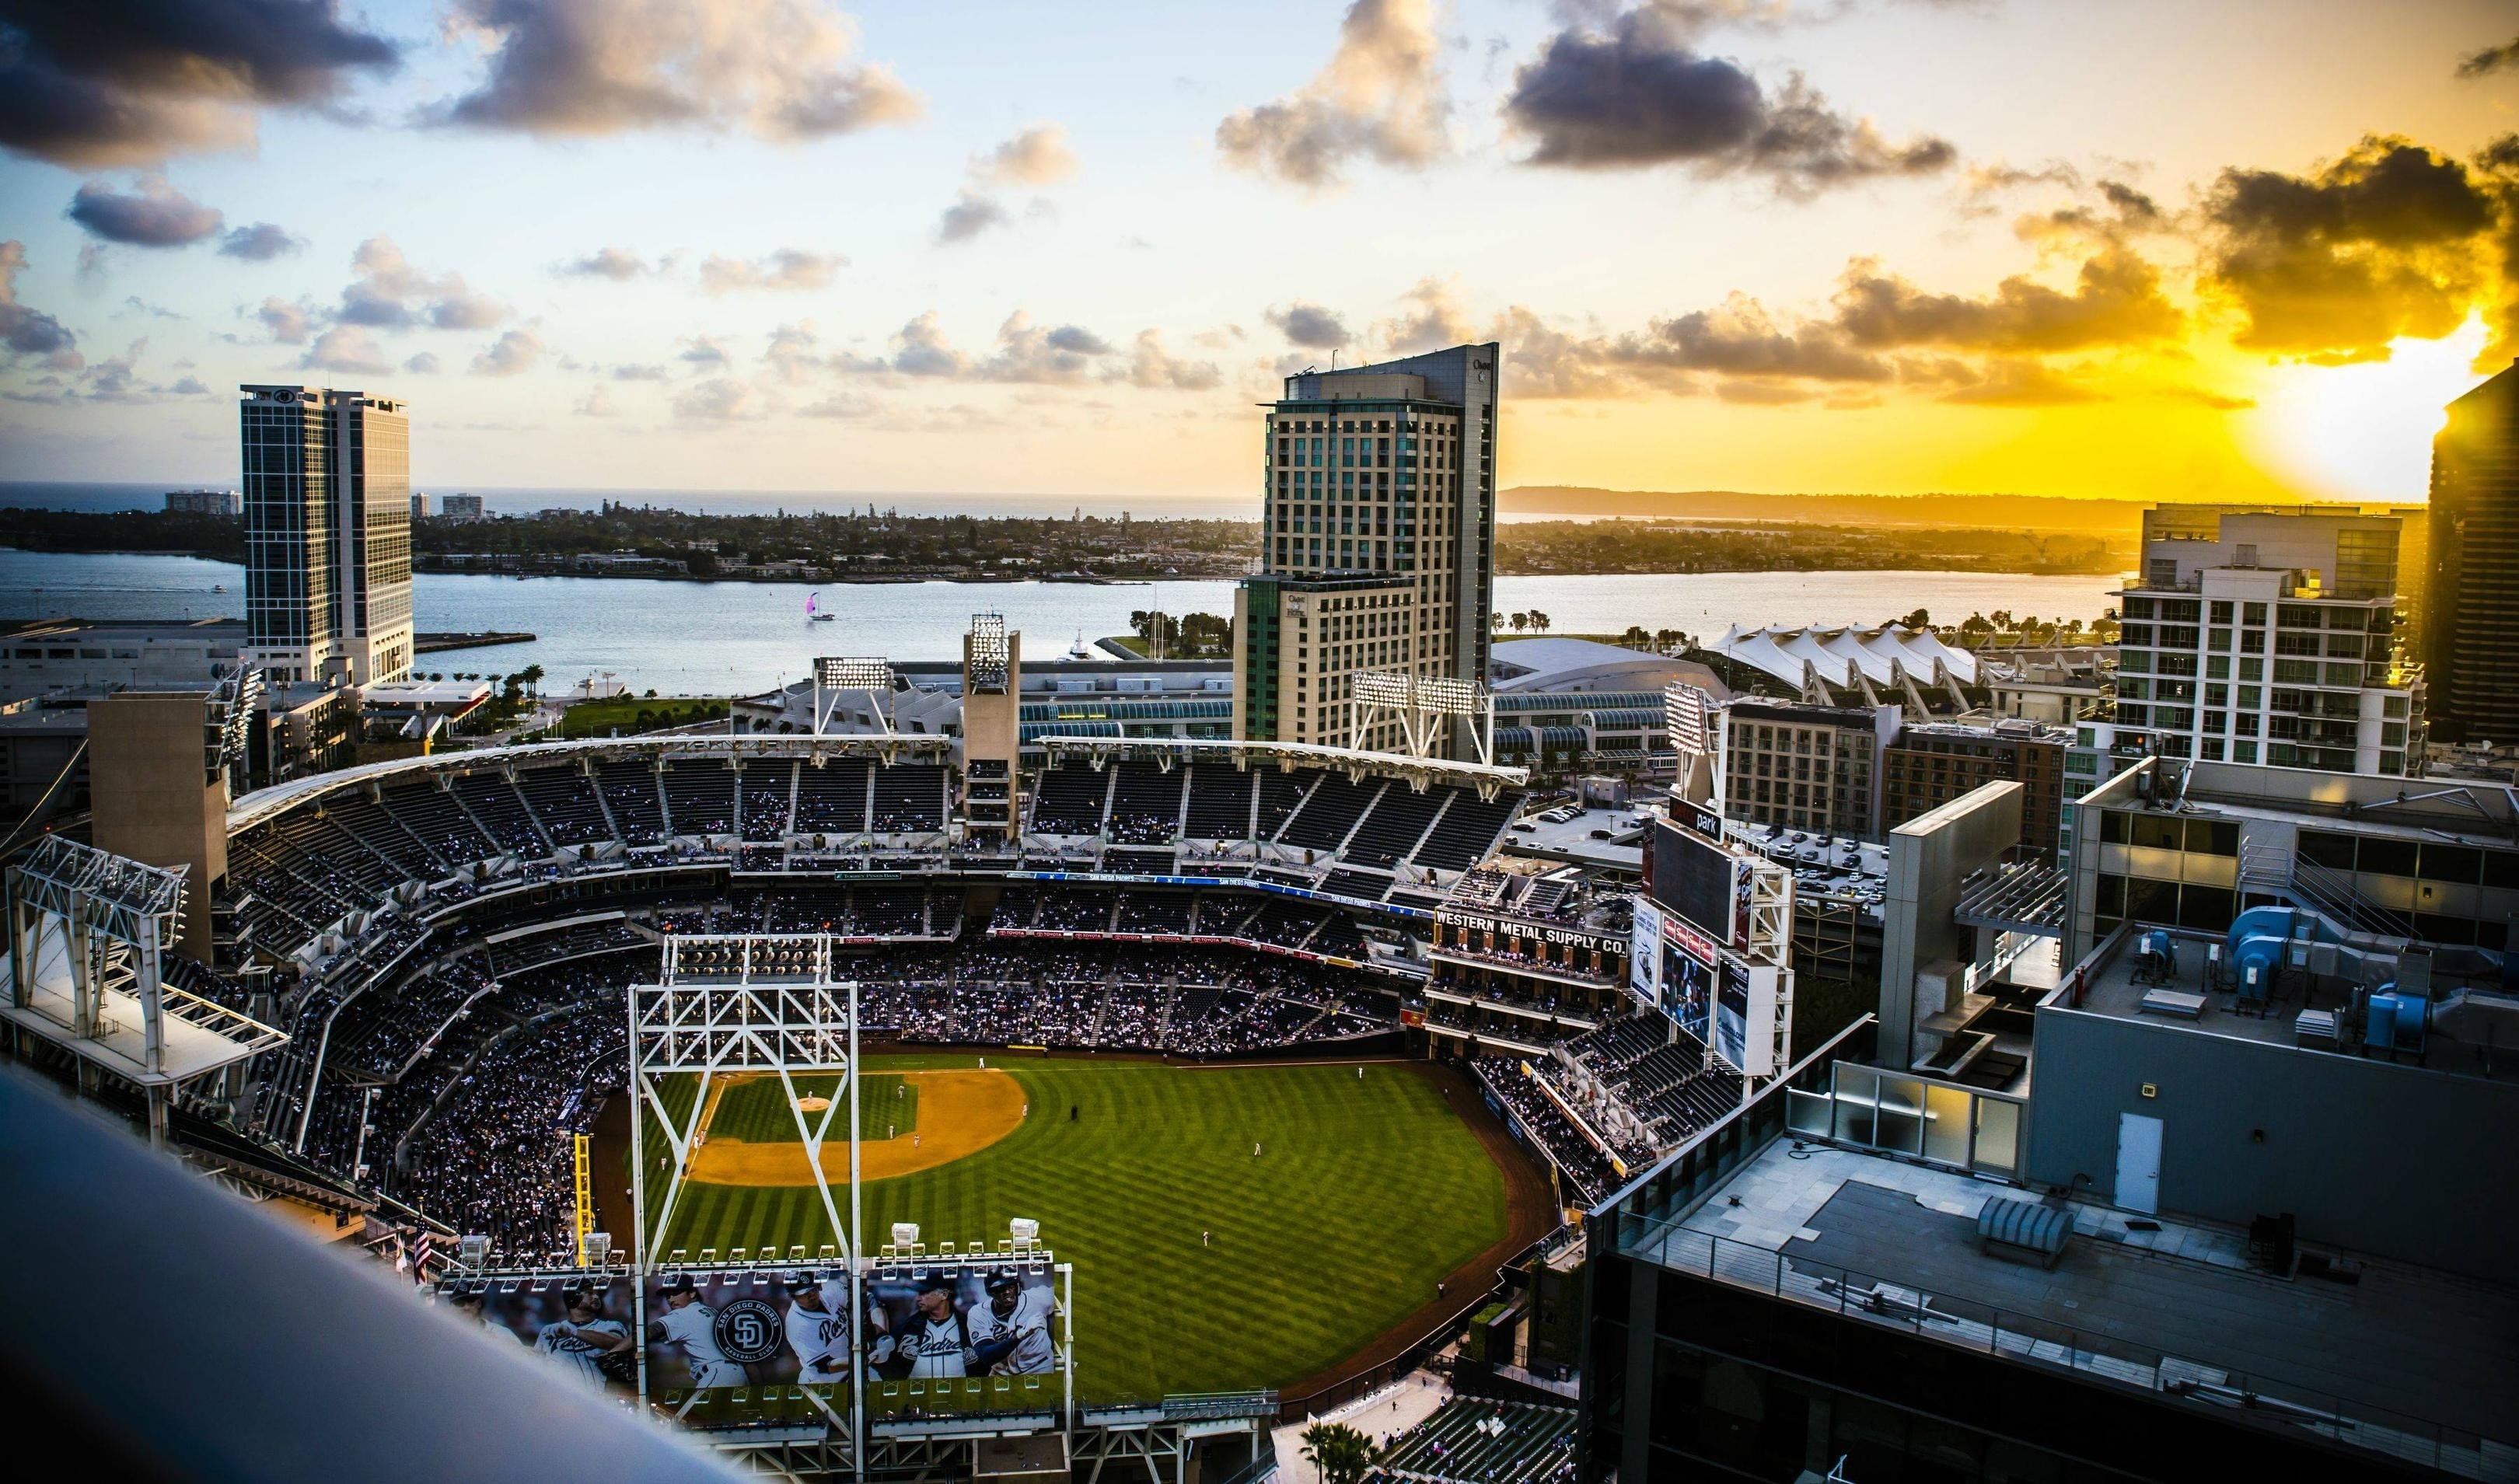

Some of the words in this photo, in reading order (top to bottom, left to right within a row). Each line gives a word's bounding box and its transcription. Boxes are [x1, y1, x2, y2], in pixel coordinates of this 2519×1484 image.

[1697, 813, 1716, 833] park
[1436, 911, 1495, 932] WESTERN
[1501, 921, 1545, 941] METAL
[1546, 930, 1598, 949] SUPPLY
[1602, 939, 1626, 955] CO.
[718, 1313, 729, 1329] SAN
[729, 1302, 753, 1314] DIEGO
[756, 1304, 779, 1327] PADRES
[735, 1314, 763, 1349] SD
[725, 1346, 756, 1359] BASEBALL
[760, 1345, 774, 1357] CLUB
